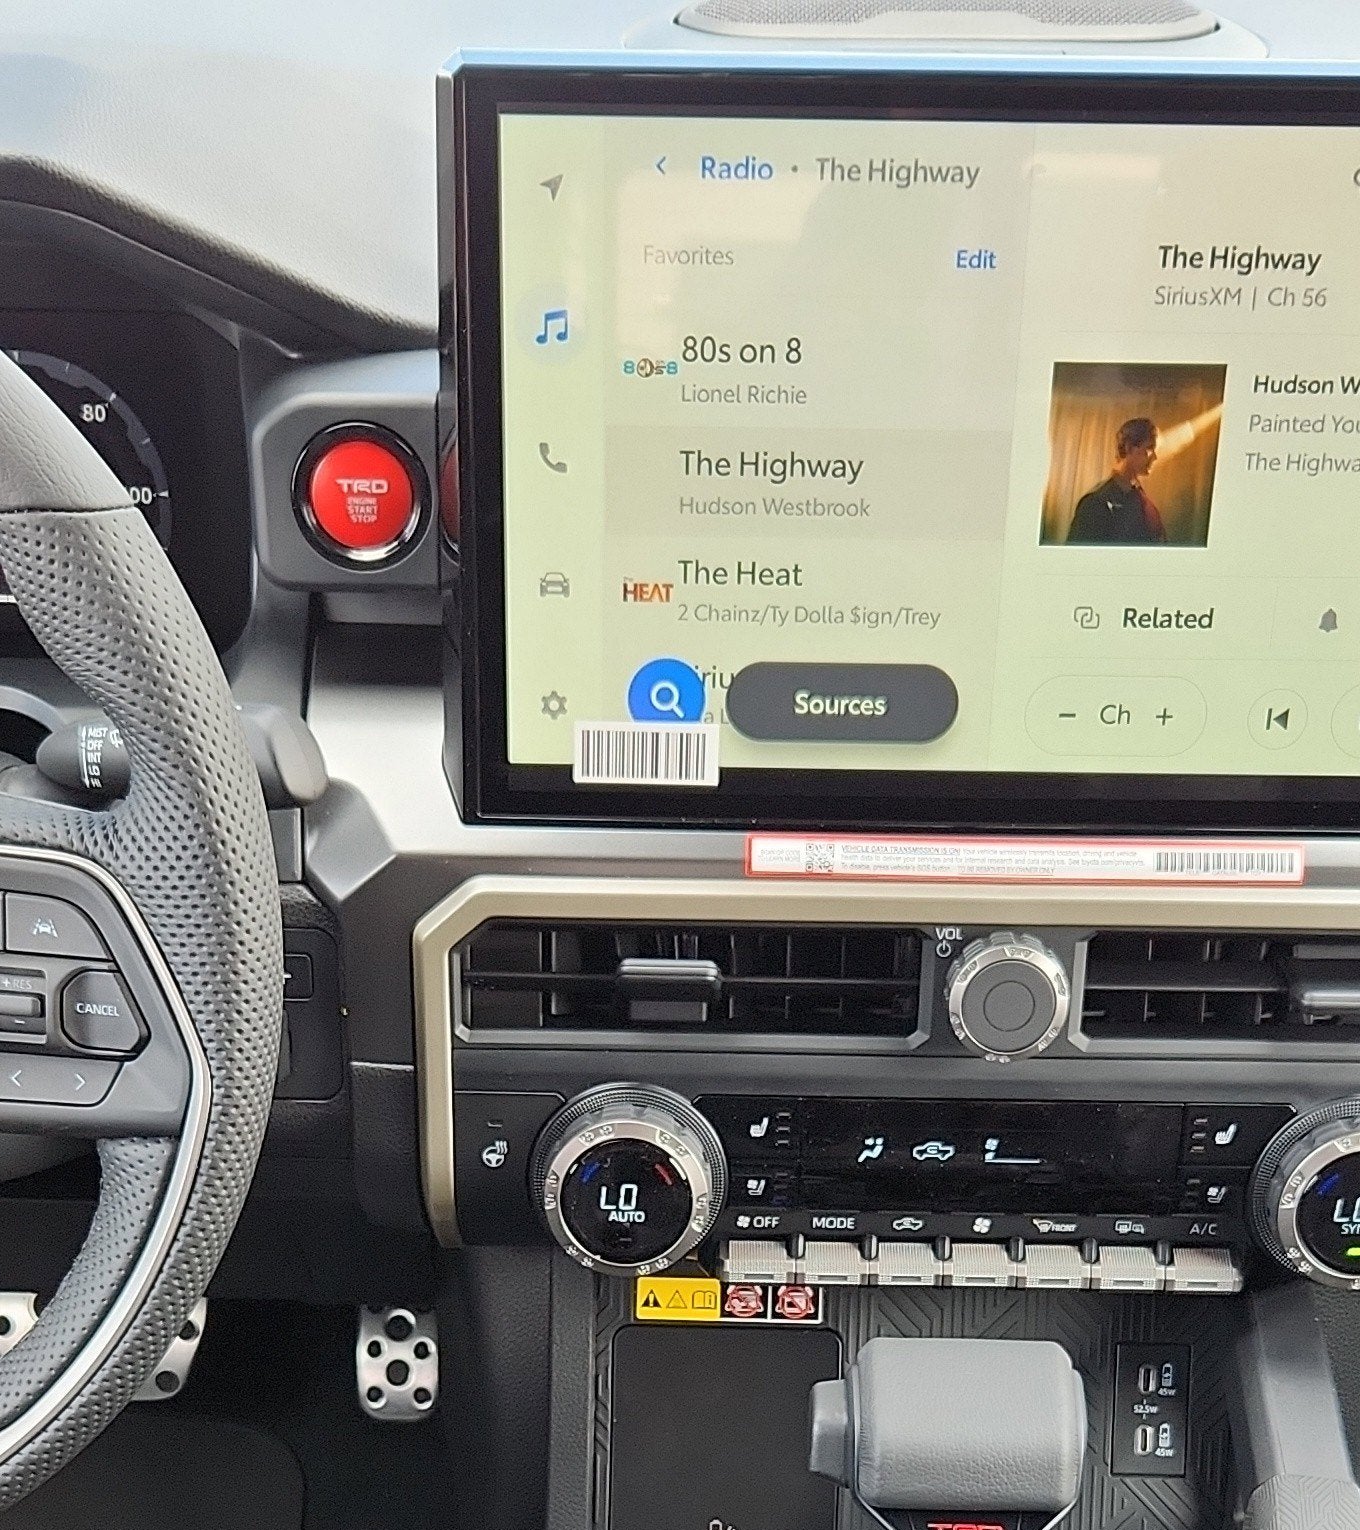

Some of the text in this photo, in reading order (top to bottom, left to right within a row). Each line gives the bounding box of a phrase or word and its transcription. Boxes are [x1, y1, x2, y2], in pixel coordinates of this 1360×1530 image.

[701, 156, 980, 188] Radio The Highway
[644, 245, 734, 266] Favorites
[956, 249, 997, 269] Edit
[1159, 245, 1322, 275] The Highway
[1155, 287, 1242, 306] SiriusXM
[1268, 288, 1297, 307] Ch
[1302, 289, 1327, 308] 56
[682, 336, 802, 364] 80s on 8
[681, 384, 807, 405] Lionel Richie
[1254, 375, 1334, 395] Hudson
[81, 403, 107, 423] 80
[1249, 415, 1326, 434] Painted
[680, 450, 864, 484] The Highway
[1246, 453, 1282, 472] The
[130, 487, 153, 505] 00
[335, 479, 389, 494] TRD
[348, 505, 378, 514] START
[679, 496, 871, 518] Hudson Westbrook
[678, 561, 802, 586] The Heat
[623, 583, 674, 602] HEAT
[678, 603, 941, 629] 2 Chainz/Ty Dolla $ign/Trey
[1123, 609, 1214, 630] Related
[794, 692, 888, 716] Sources
[1100, 705, 1131, 725] Ch
[88, 727, 108, 738] MIST
[87, 740, 103, 751] OFF
[87, 752, 101, 763] INT
[88, 765, 100, 776] LO
[935, 928, 963, 941] VOL
[76, 1003, 119, 1017] CANCEL
[600, 1184, 638, 1210] LO
[608, 1211, 646, 1223] AUTO
[753, 1216, 780, 1228] OFF
[812, 1217, 855, 1229] MODE
[1190, 1223, 1217, 1235] A/C
[1158, 1387, 1176, 1396] 45W
[1155, 1448, 1173, 1457] 45W
